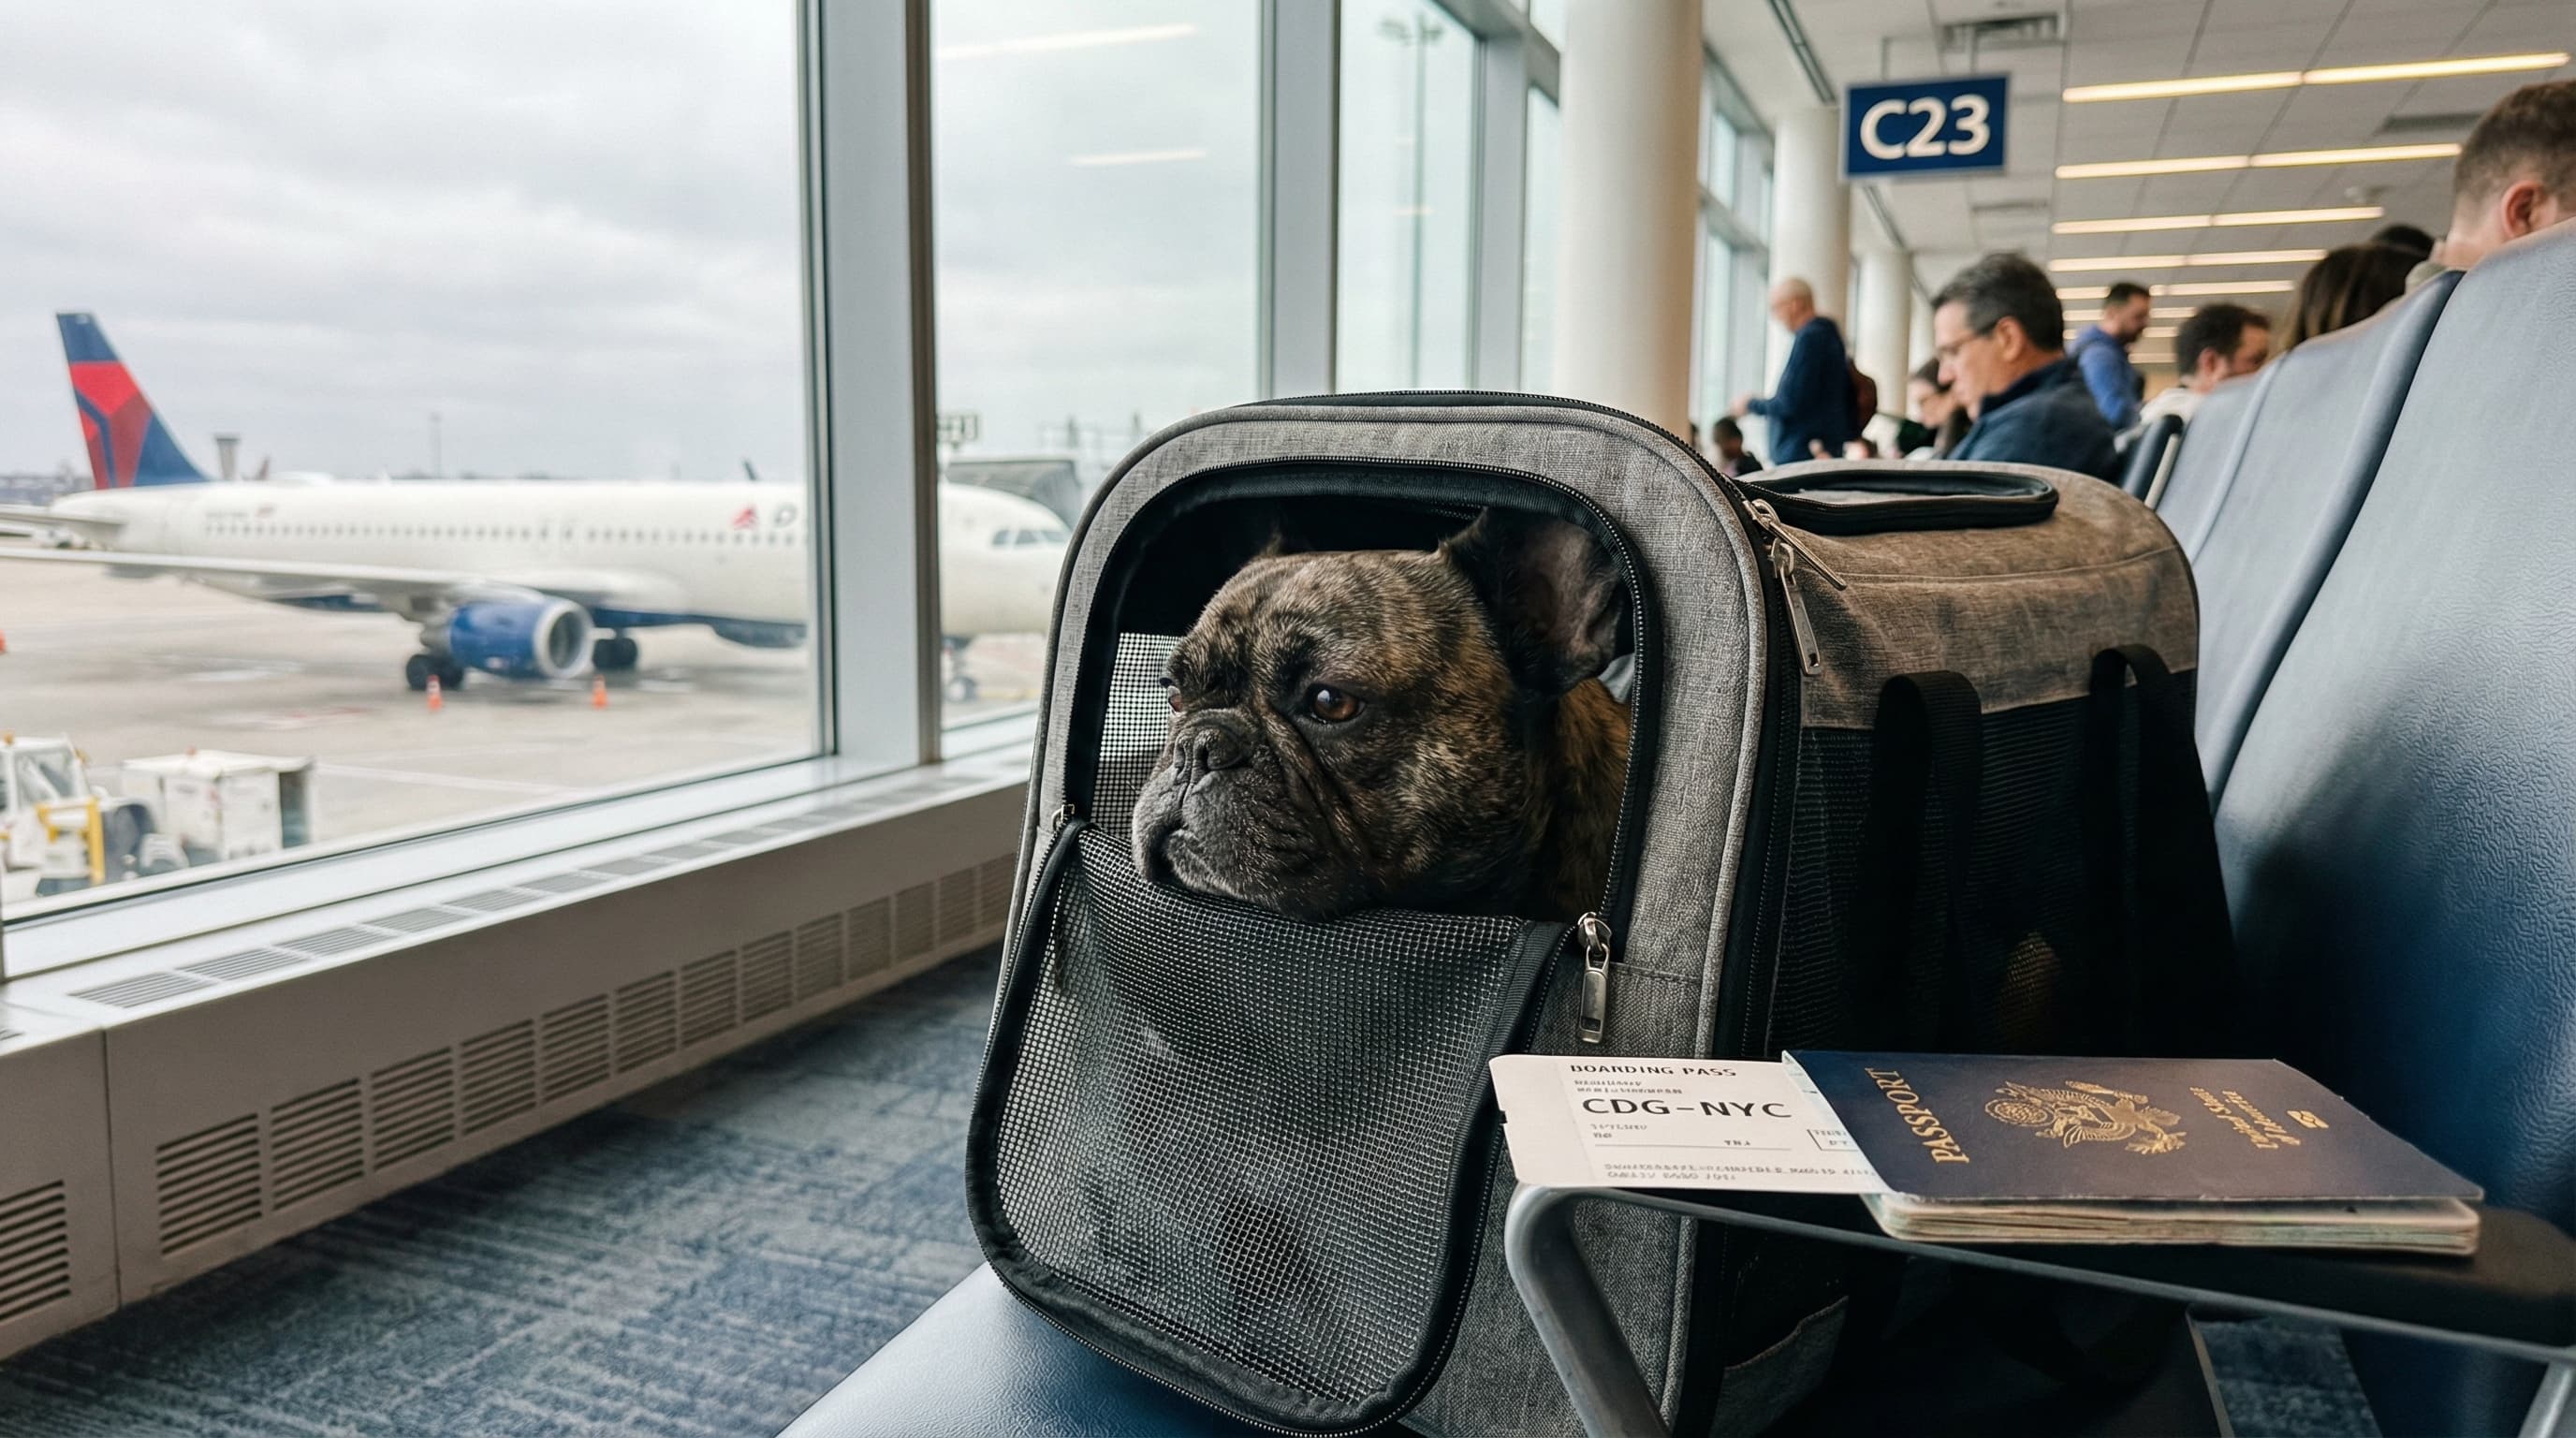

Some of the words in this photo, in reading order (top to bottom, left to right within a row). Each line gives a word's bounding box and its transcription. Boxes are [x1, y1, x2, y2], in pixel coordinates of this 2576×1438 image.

[1860, 94, 1990, 160] C23
[1570, 1064, 1674, 1075] BOARDING
[1682, 1067, 1736, 1077] PASS
[1582, 1098, 1793, 1118] CDG-NYC
[1864, 1067, 1969, 1164] PASSPORT
